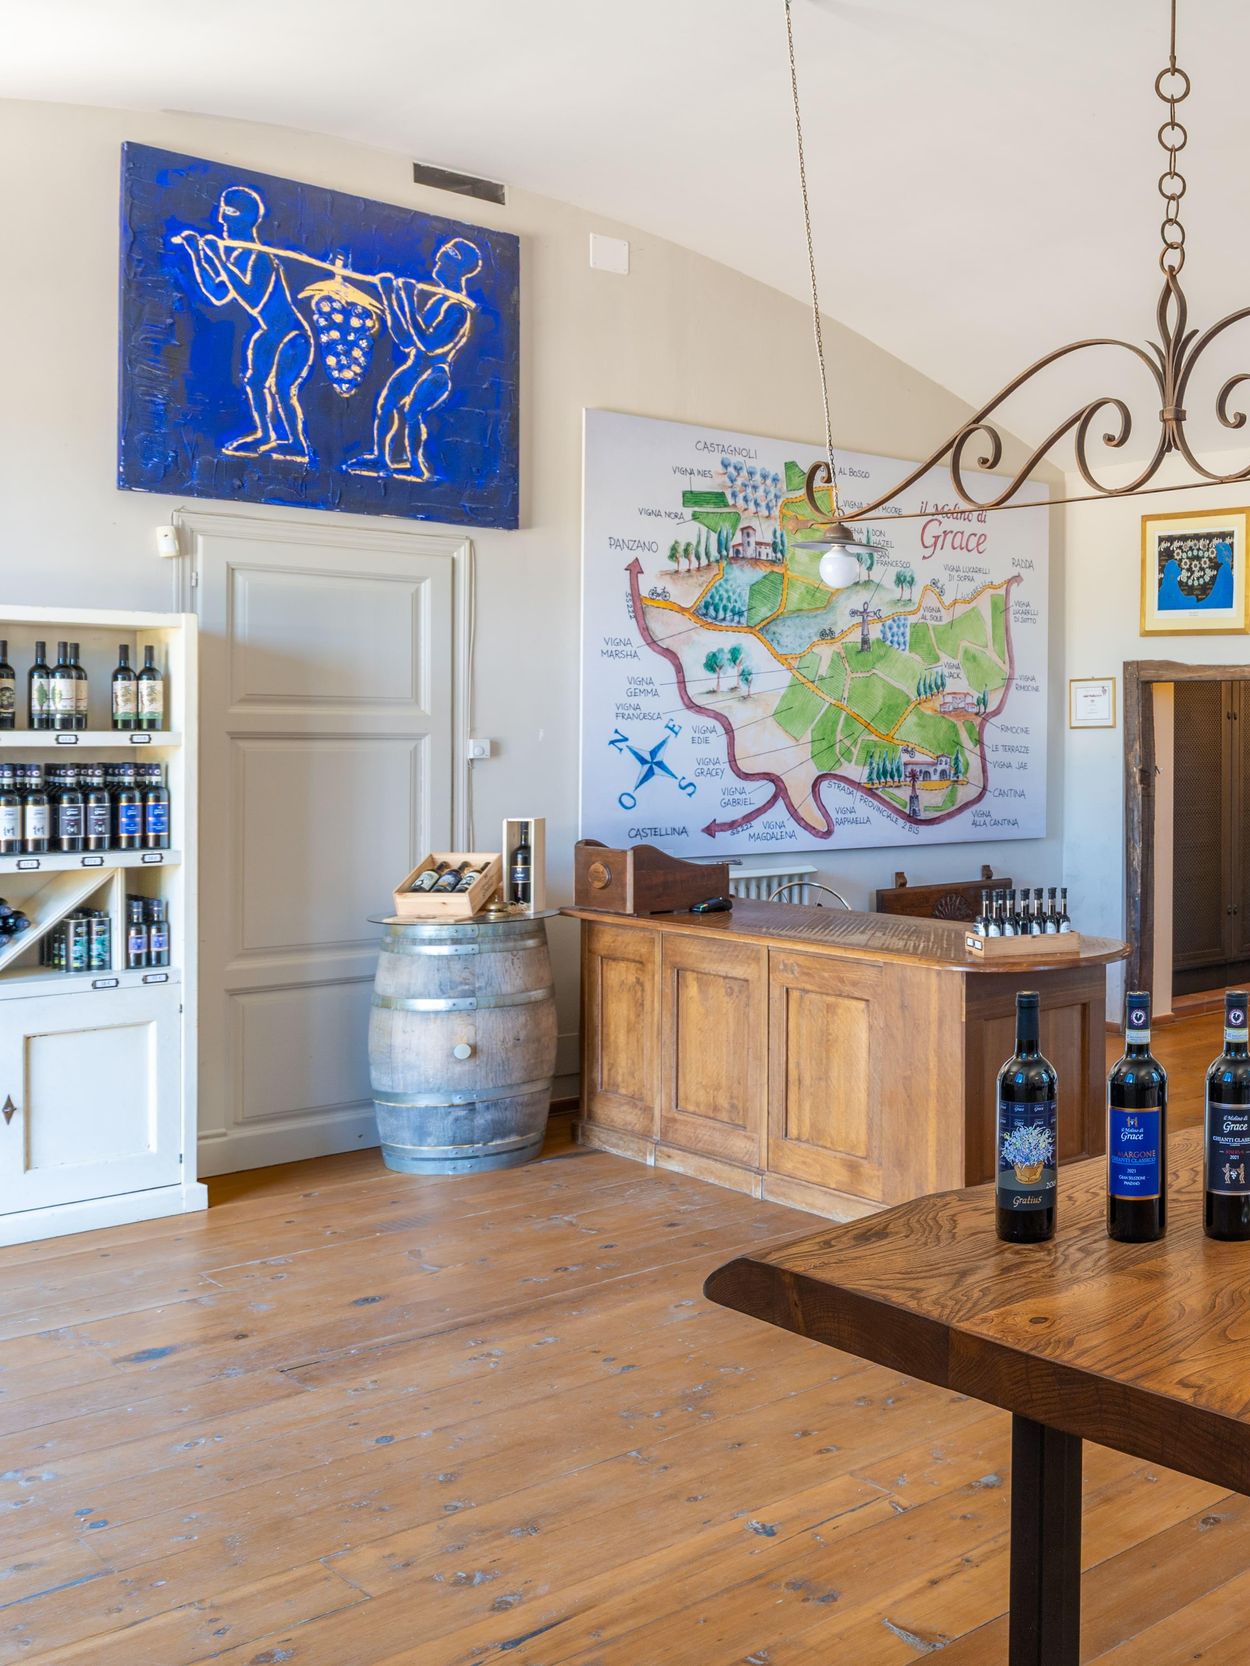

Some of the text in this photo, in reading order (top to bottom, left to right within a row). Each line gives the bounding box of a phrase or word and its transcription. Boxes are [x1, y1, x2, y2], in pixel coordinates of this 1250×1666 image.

[695, 441, 757, 460] CASTAGNOLI
[672, 466, 713, 478] VIGNA INES
[838, 468, 846, 476] AL
[638, 508, 686, 520] VIGNA NORA
[920, 501, 928, 514] il
[976, 508, 988, 524] di
[872, 528, 886, 537] DON
[872, 539, 894, 548] HAZEL
[920, 518, 988, 560] Grace
[608, 536, 659, 554] PANZANO
[876, 551, 890, 560] SAN
[876, 560, 911, 568] FRANCESCO
[944, 564, 961, 572] VIGNA
[1012, 558, 1034, 571] RADDA
[922, 606, 941, 614] VIGNA
[931, 614, 944, 622] SOLE
[604, 637, 632, 648] VIGNA
[601, 650, 640, 660] MARSHA
[944, 662, 962, 670] VIGNA
[627, 676, 654, 686] VIGNA
[626, 688, 660, 698] GEMMA
[616, 704, 641, 712] VIGNA
[616, 712, 662, 720] FRANCESCA
[664, 718, 682, 738] E
[692, 726, 717, 734] VIGNA
[608, 728, 629, 752] N
[692, 736, 710, 744] EDIE
[992, 744, 1000, 753] LE
[696, 758, 720, 766] VIGNA
[992, 762, 1012, 770] VIGNA
[694, 768, 725, 778] GRACEY
[678, 776, 696, 798] S
[721, 788, 746, 796] VIGNA
[992, 788, 1026, 798] CANTINA
[618, 792, 637, 810] O
[720, 797, 756, 808] GABRIEL
[826, 780, 856, 798] STRADA
[860, 796, 898, 826] PROVINCIALE
[835, 807, 856, 816] VIGNA
[971, 810, 992, 818] VIGNA
[762, 821, 786, 830] VIGNA
[835, 816, 872, 826] RAPHAELLA
[971, 818, 1018, 827] ALLA CANTINA
[628, 826, 688, 840] CASTELLINA
[748, 830, 798, 841] MAGDALENA
[1223, 1122, 1248, 1133] Grace
[1120, 1132, 1144, 1142] Grace
[1013, 1196, 1042, 1208] Gratius
